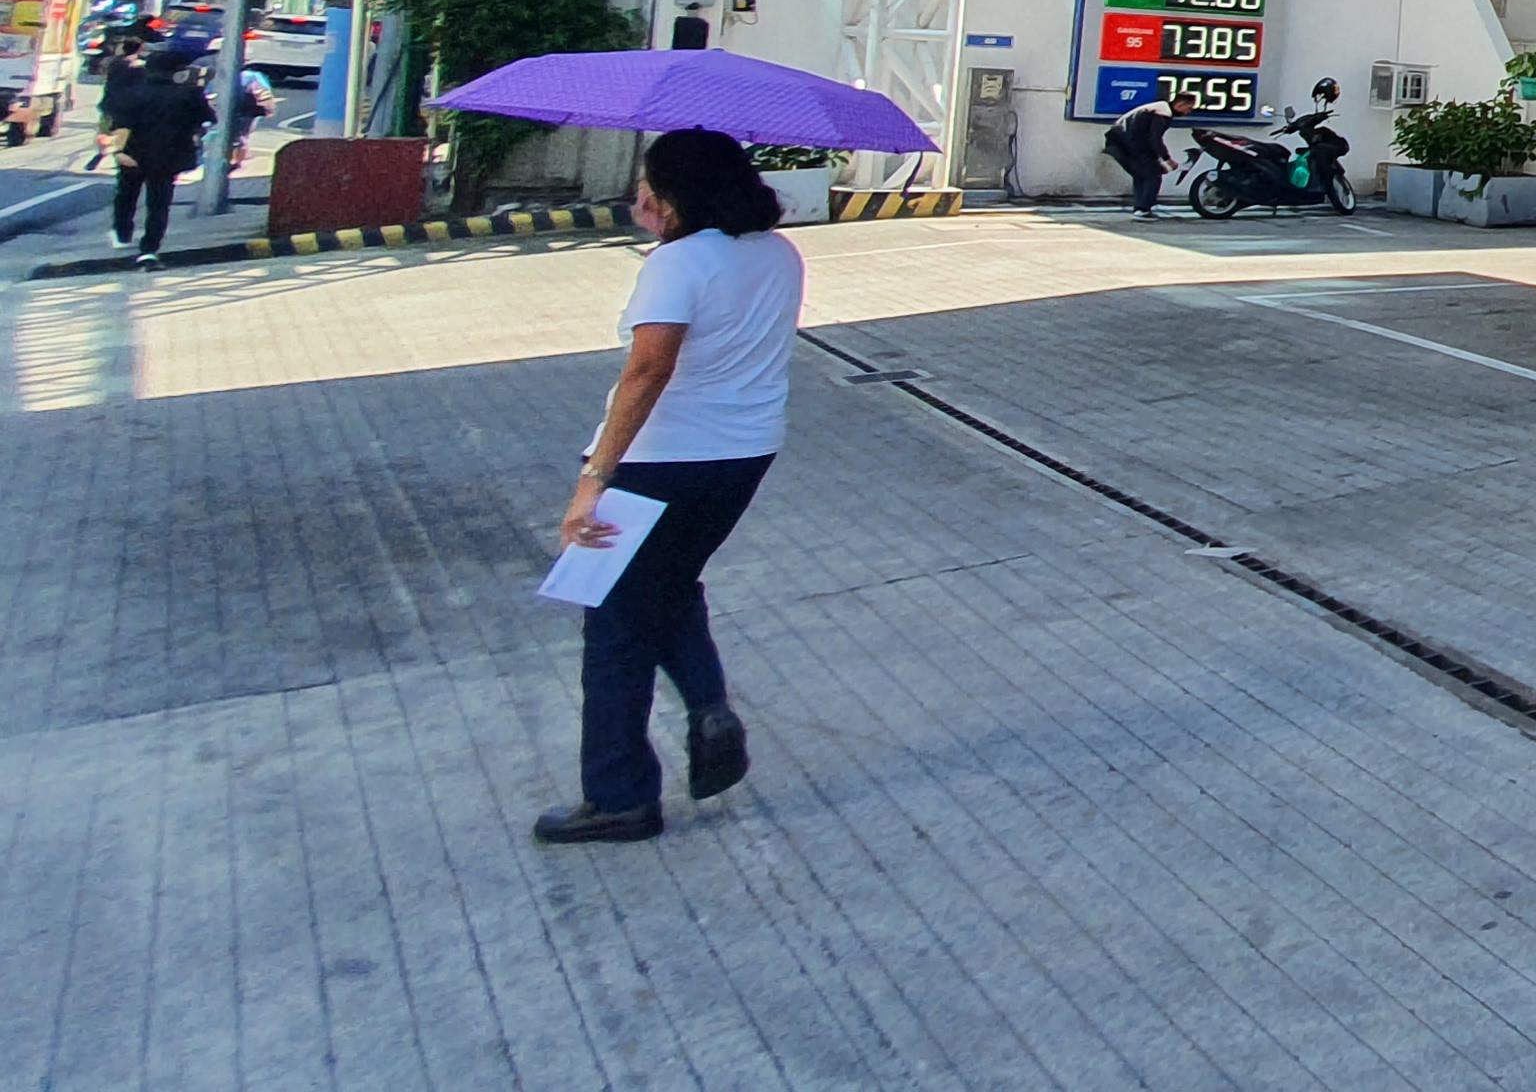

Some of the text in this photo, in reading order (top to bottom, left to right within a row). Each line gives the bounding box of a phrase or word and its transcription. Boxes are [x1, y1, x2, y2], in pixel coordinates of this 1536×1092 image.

[1125, 36, 1143, 48] 95
[1162, 23, 1257, 61] 73.85
[1120, 89, 1138, 101] 97
[1157, 75, 1252, 112] 75.55
